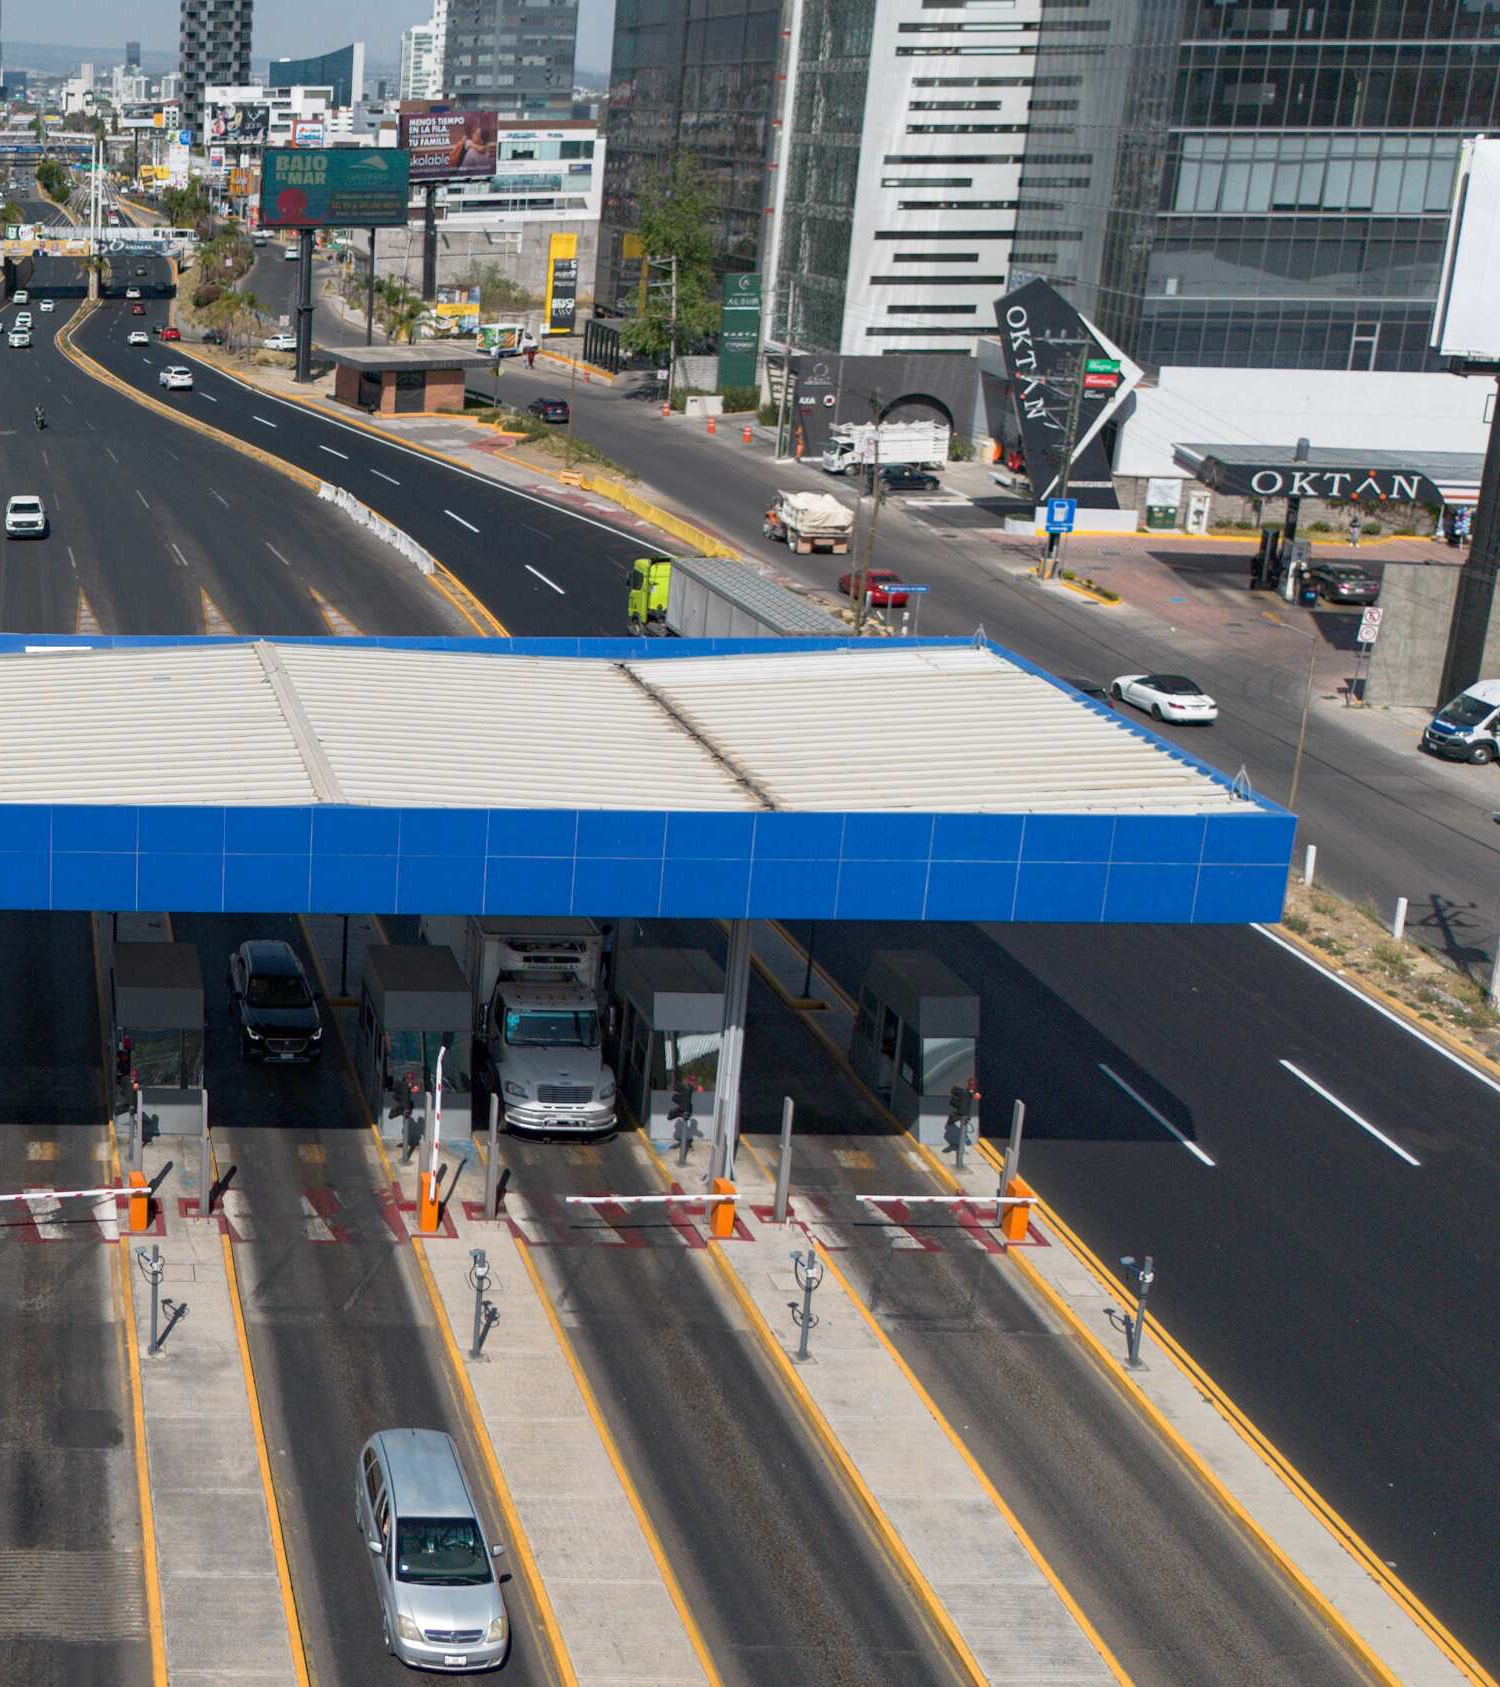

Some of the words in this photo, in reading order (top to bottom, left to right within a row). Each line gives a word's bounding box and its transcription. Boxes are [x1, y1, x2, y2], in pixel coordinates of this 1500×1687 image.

[409, 118, 436, 126] MENOS
[438, 116, 465, 125] TIEMPO
[409, 126, 419, 134] EN
[420, 125, 430, 133] LA
[409, 139, 419, 147] TU
[420, 137, 450, 146] FAMILIA
[276, 155, 328, 171] BAJO
[287, 171, 326, 184] MAR
